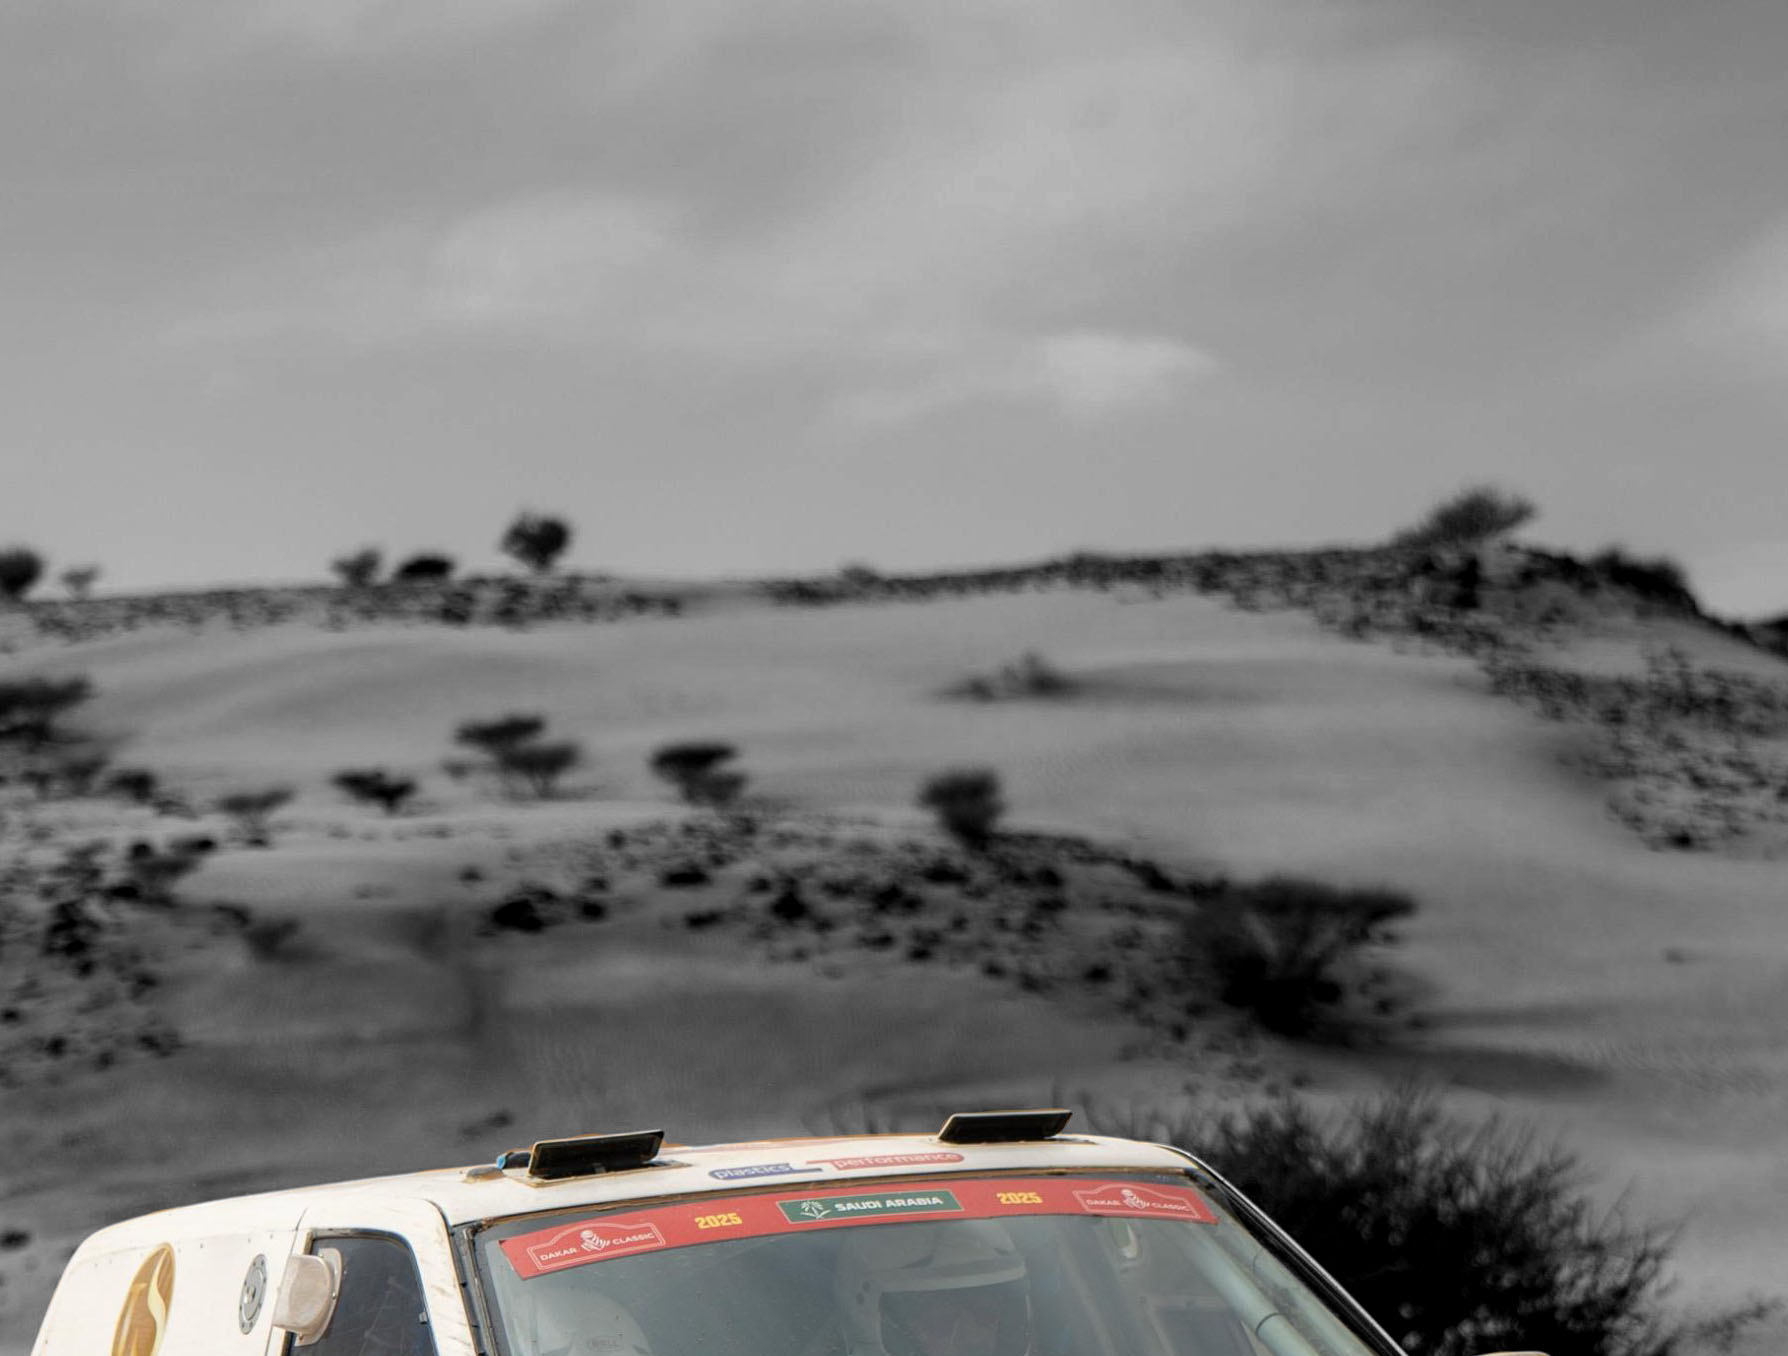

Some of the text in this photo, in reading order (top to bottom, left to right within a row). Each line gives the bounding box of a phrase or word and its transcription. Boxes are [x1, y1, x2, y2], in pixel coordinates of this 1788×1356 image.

[714, 1153, 961, 1179] plastics performance
[833, 1196, 943, 1212] SAUDI ARABIA
[997, 1191, 1043, 1205] 2025
[694, 1212, 743, 1229] 2025
[539, 1231, 655, 1262] DAKAR CLASSIC
